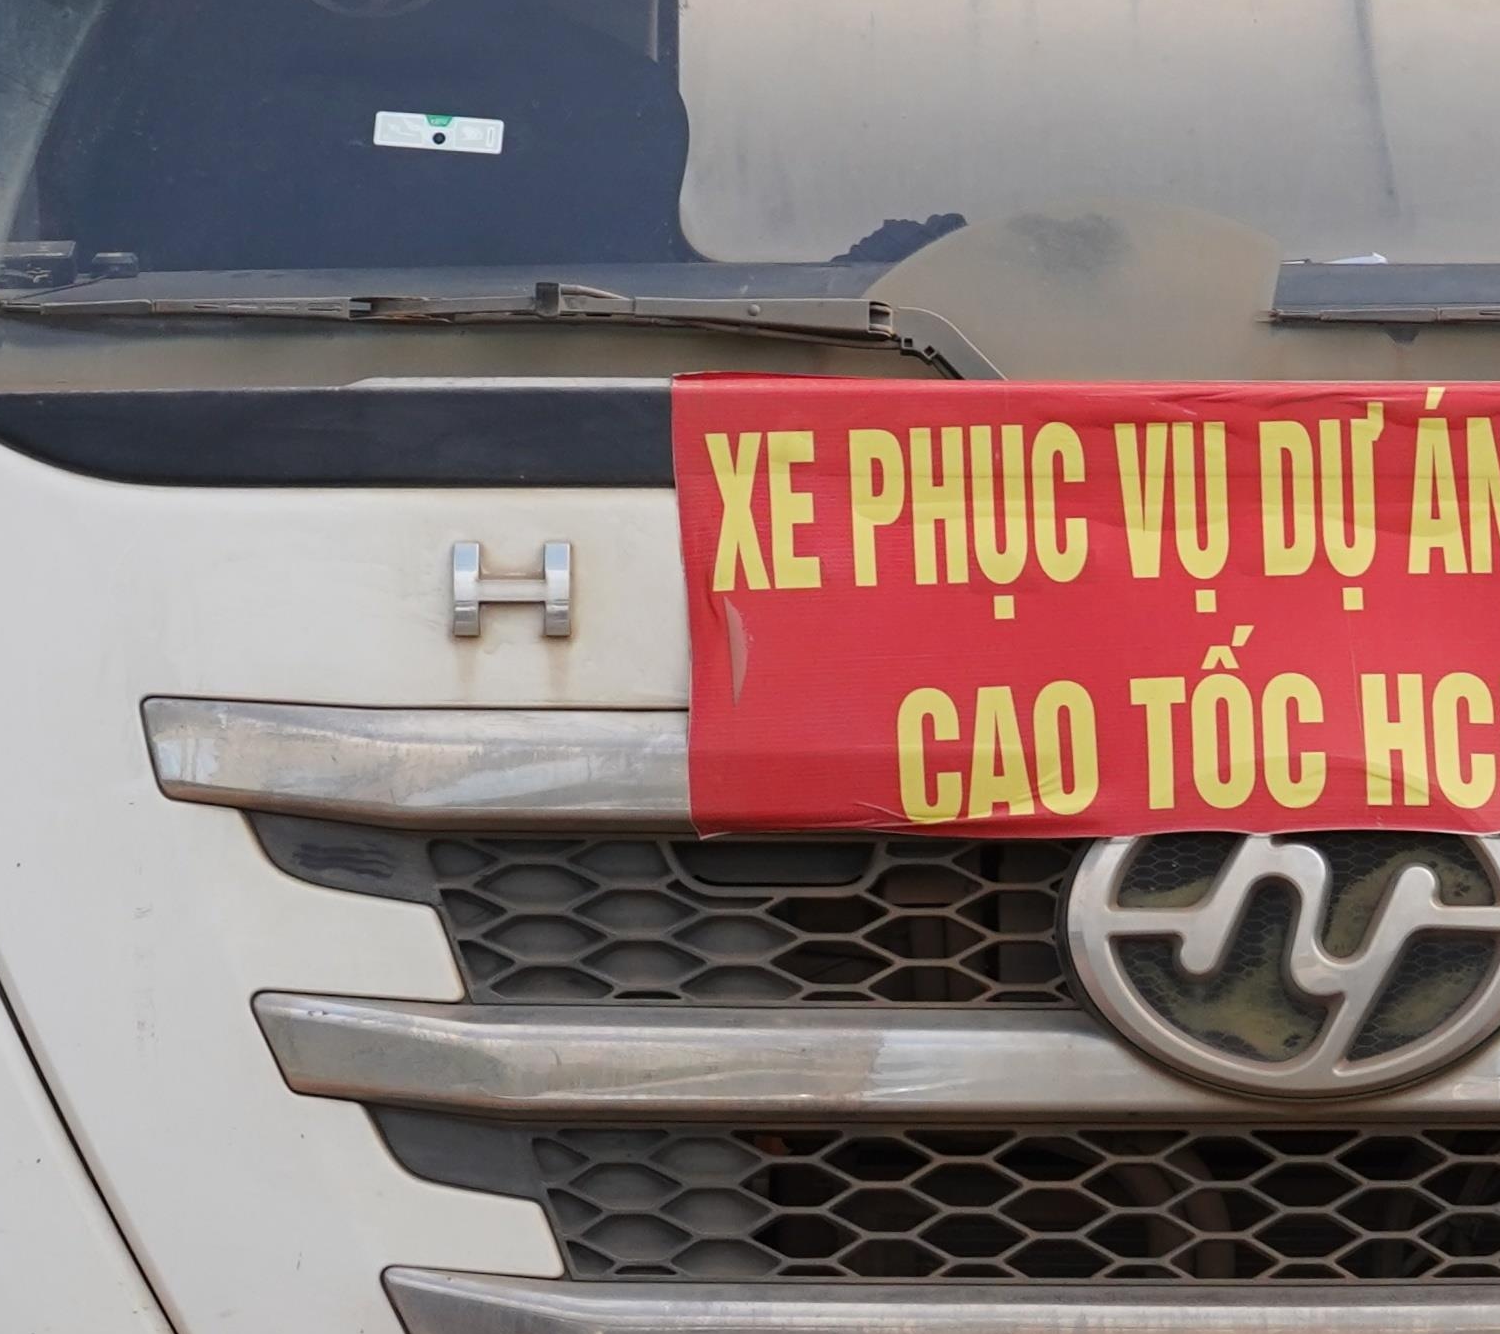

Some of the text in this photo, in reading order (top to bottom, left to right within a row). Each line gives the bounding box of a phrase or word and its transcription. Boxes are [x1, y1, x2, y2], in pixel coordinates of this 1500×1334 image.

[704, 429, 822, 594] XE
[848, 420, 1090, 622] PHỤC
[1112, 420, 1231, 614] VỤ
[1257, 400, 1385, 612] DỰ
[896, 679, 1100, 827] CAO
[1129, 623, 1328, 812] TỐC
